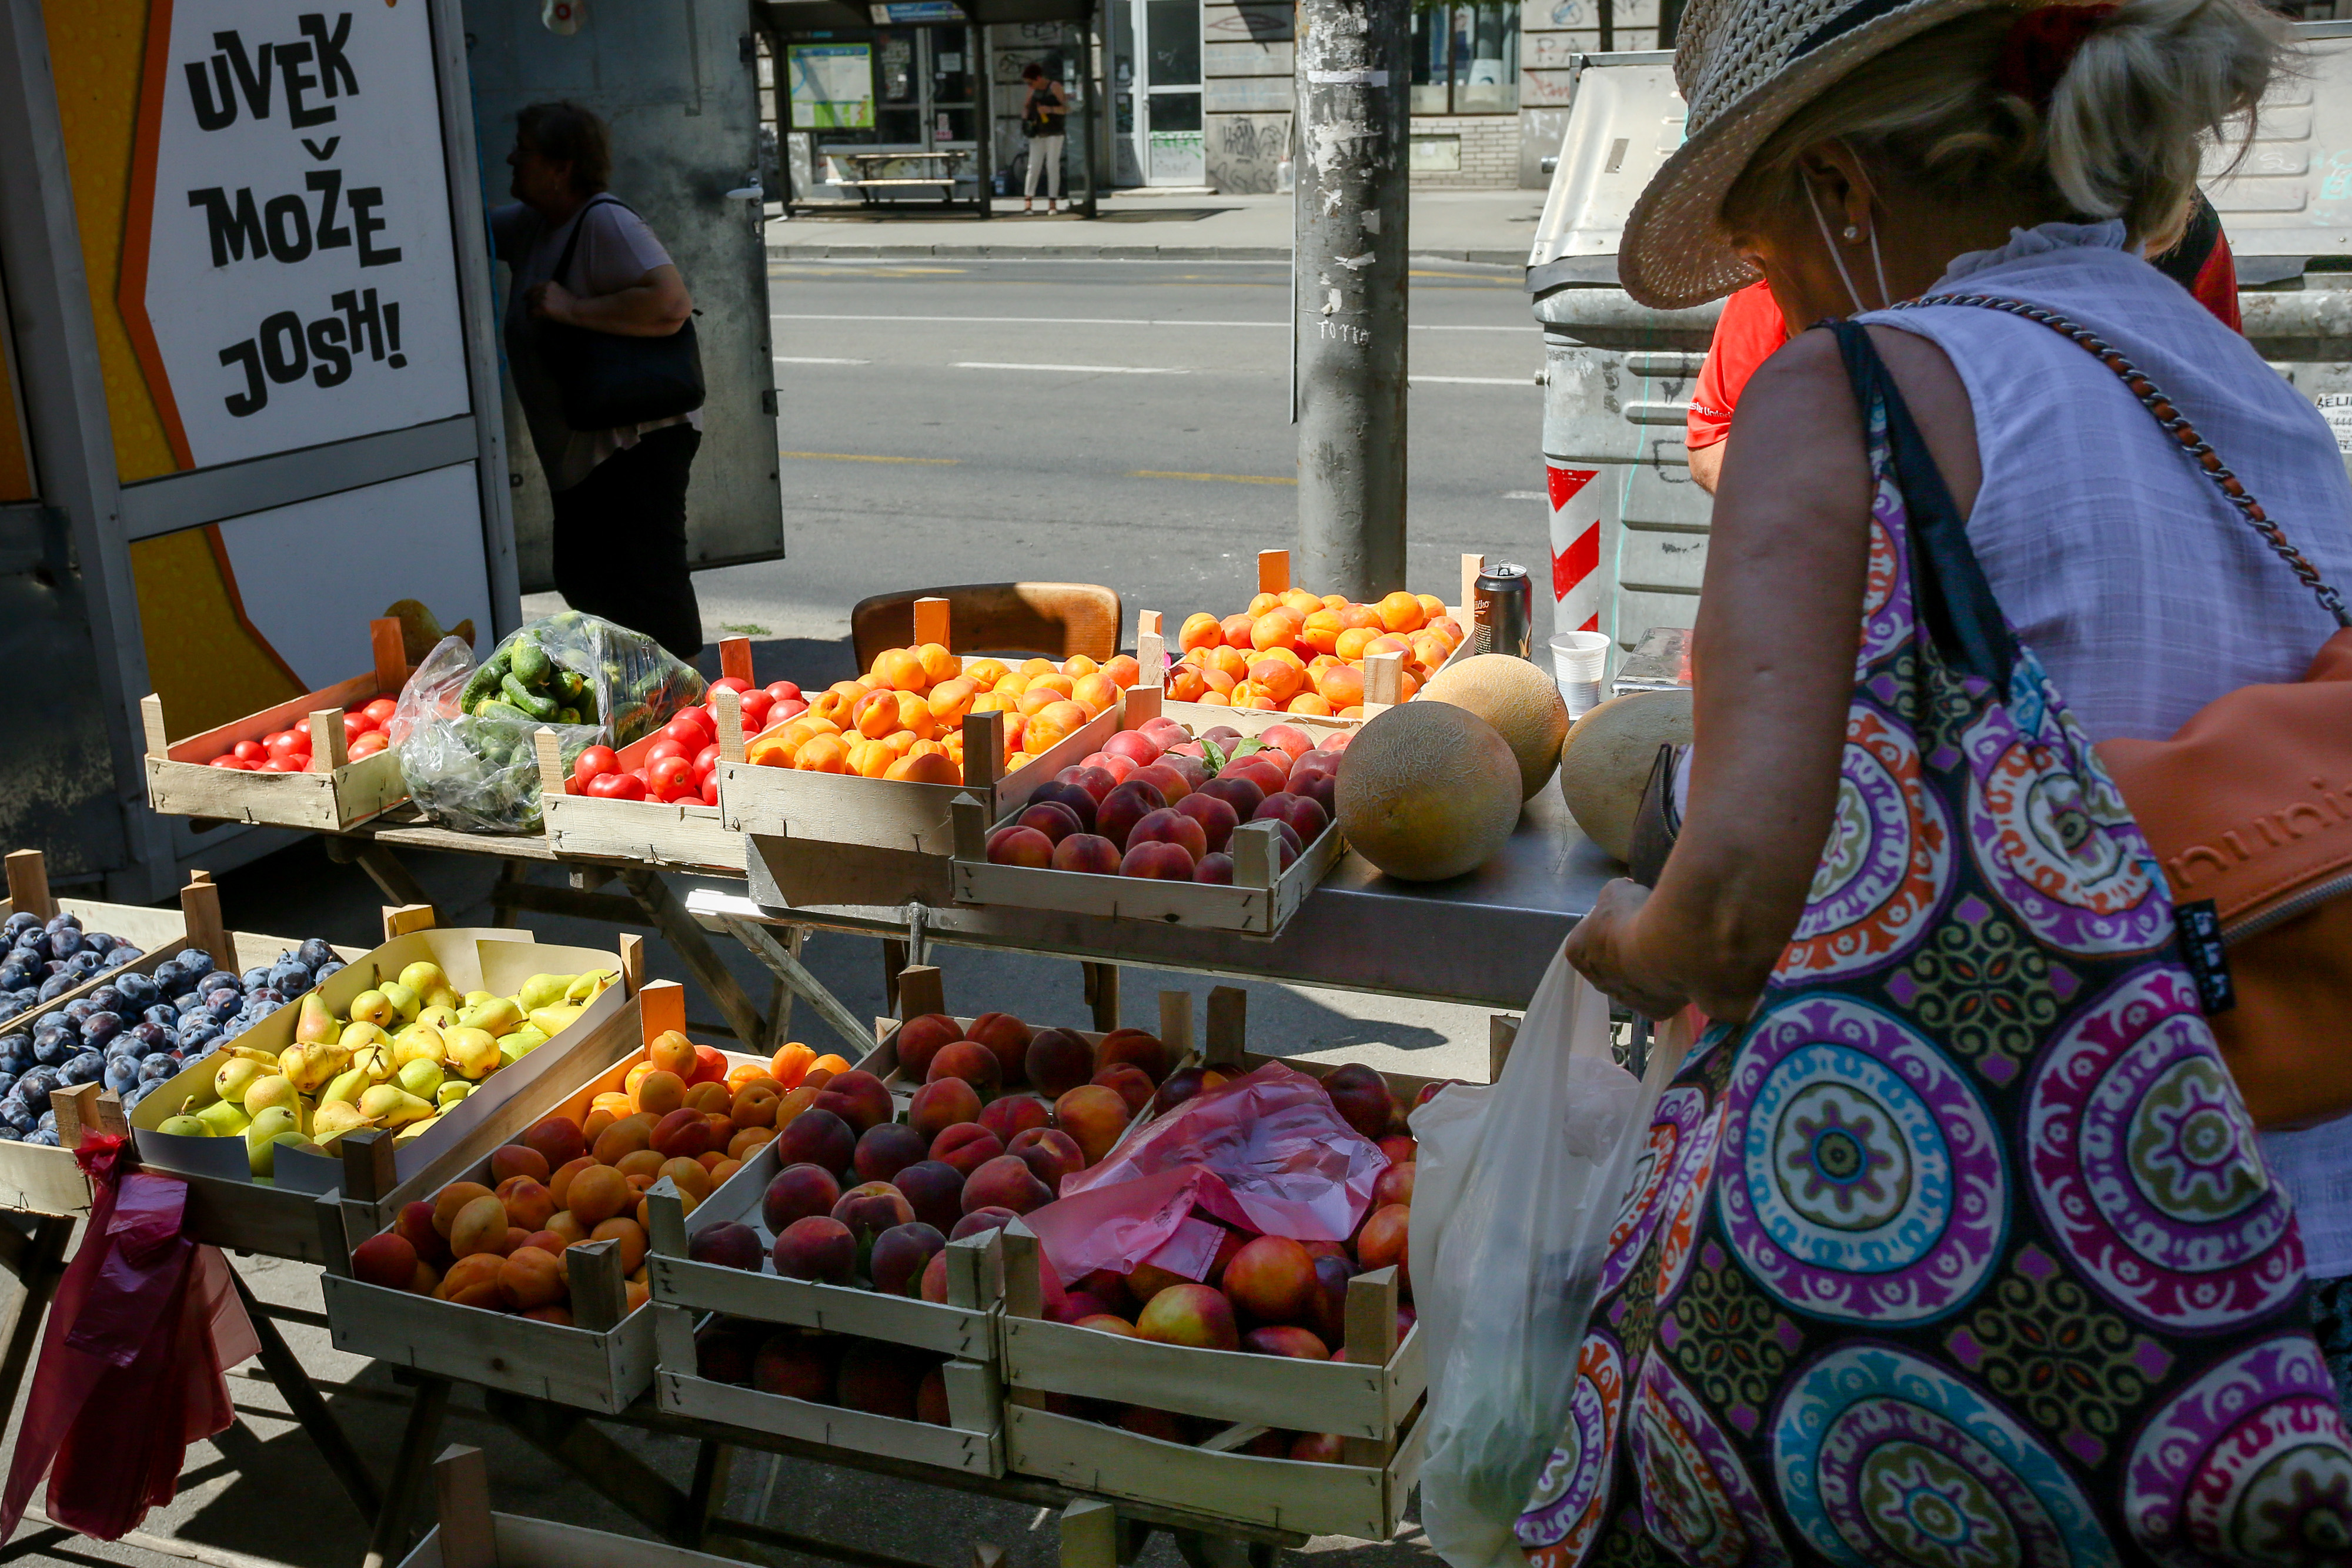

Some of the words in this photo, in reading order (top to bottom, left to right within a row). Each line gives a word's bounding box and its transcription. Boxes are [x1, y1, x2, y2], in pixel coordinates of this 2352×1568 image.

[183, 12, 360, 132] UVEK
[187, 136, 402, 269] MOŽE
[218, 287, 407, 418] JOSH!
